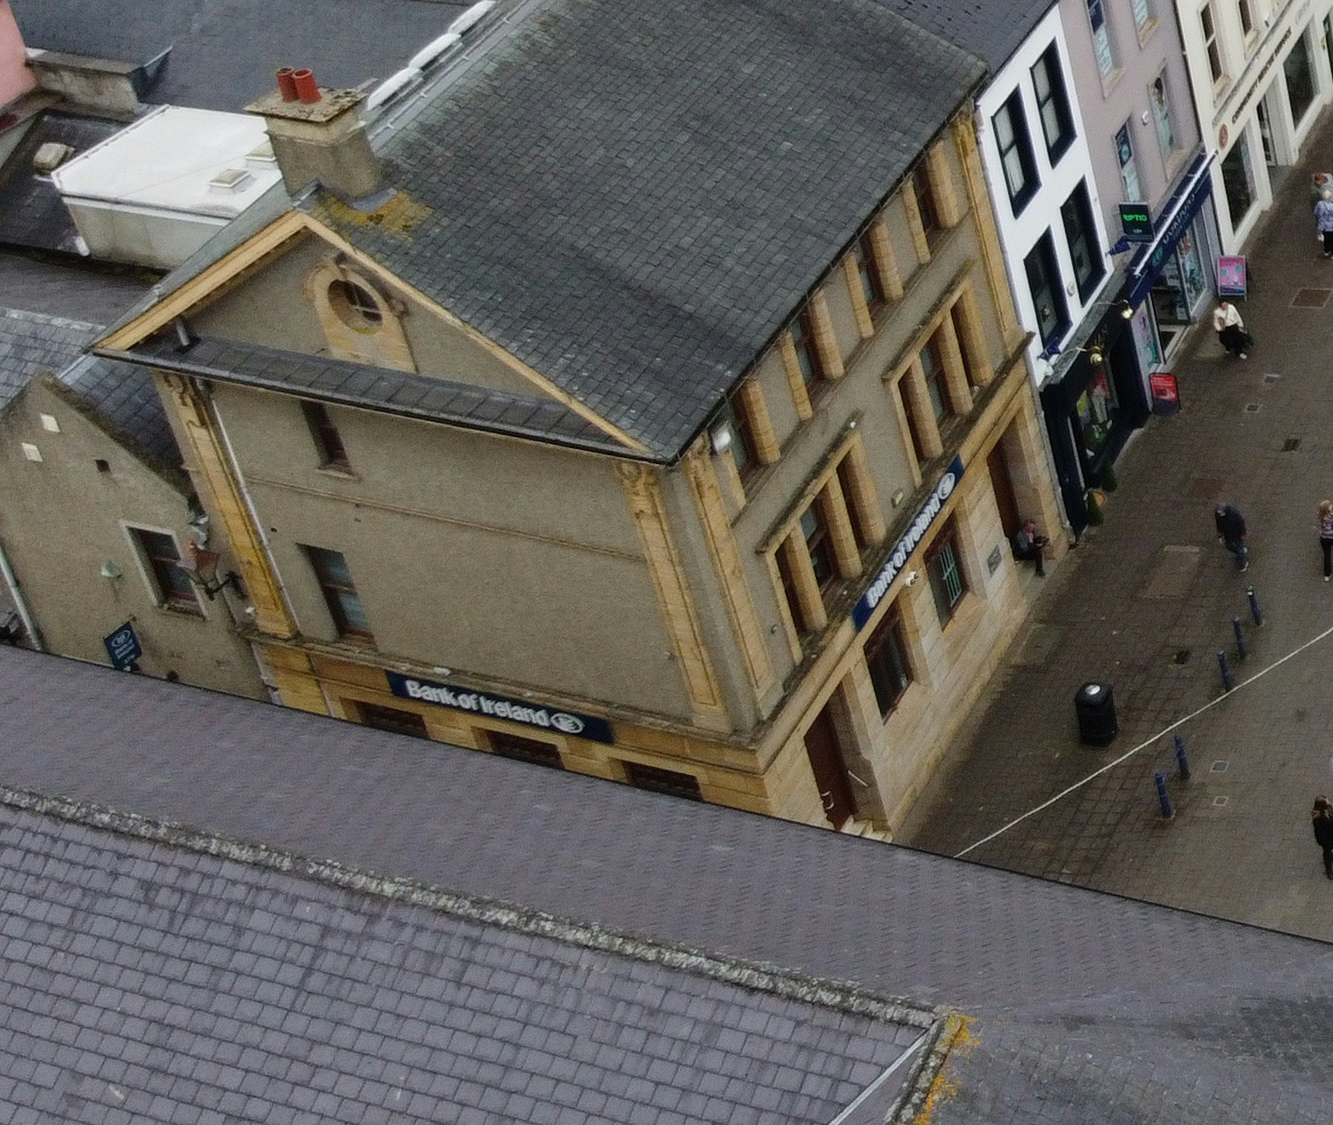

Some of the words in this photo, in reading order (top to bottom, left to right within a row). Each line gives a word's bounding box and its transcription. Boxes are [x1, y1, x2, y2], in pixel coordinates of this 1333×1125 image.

[866, 560, 898, 608] Bank
[902, 492, 941, 553] Ireland
[405, 679, 459, 707] Bank
[457, 693, 479, 711] of
[479, 696, 551, 727] Ireland
